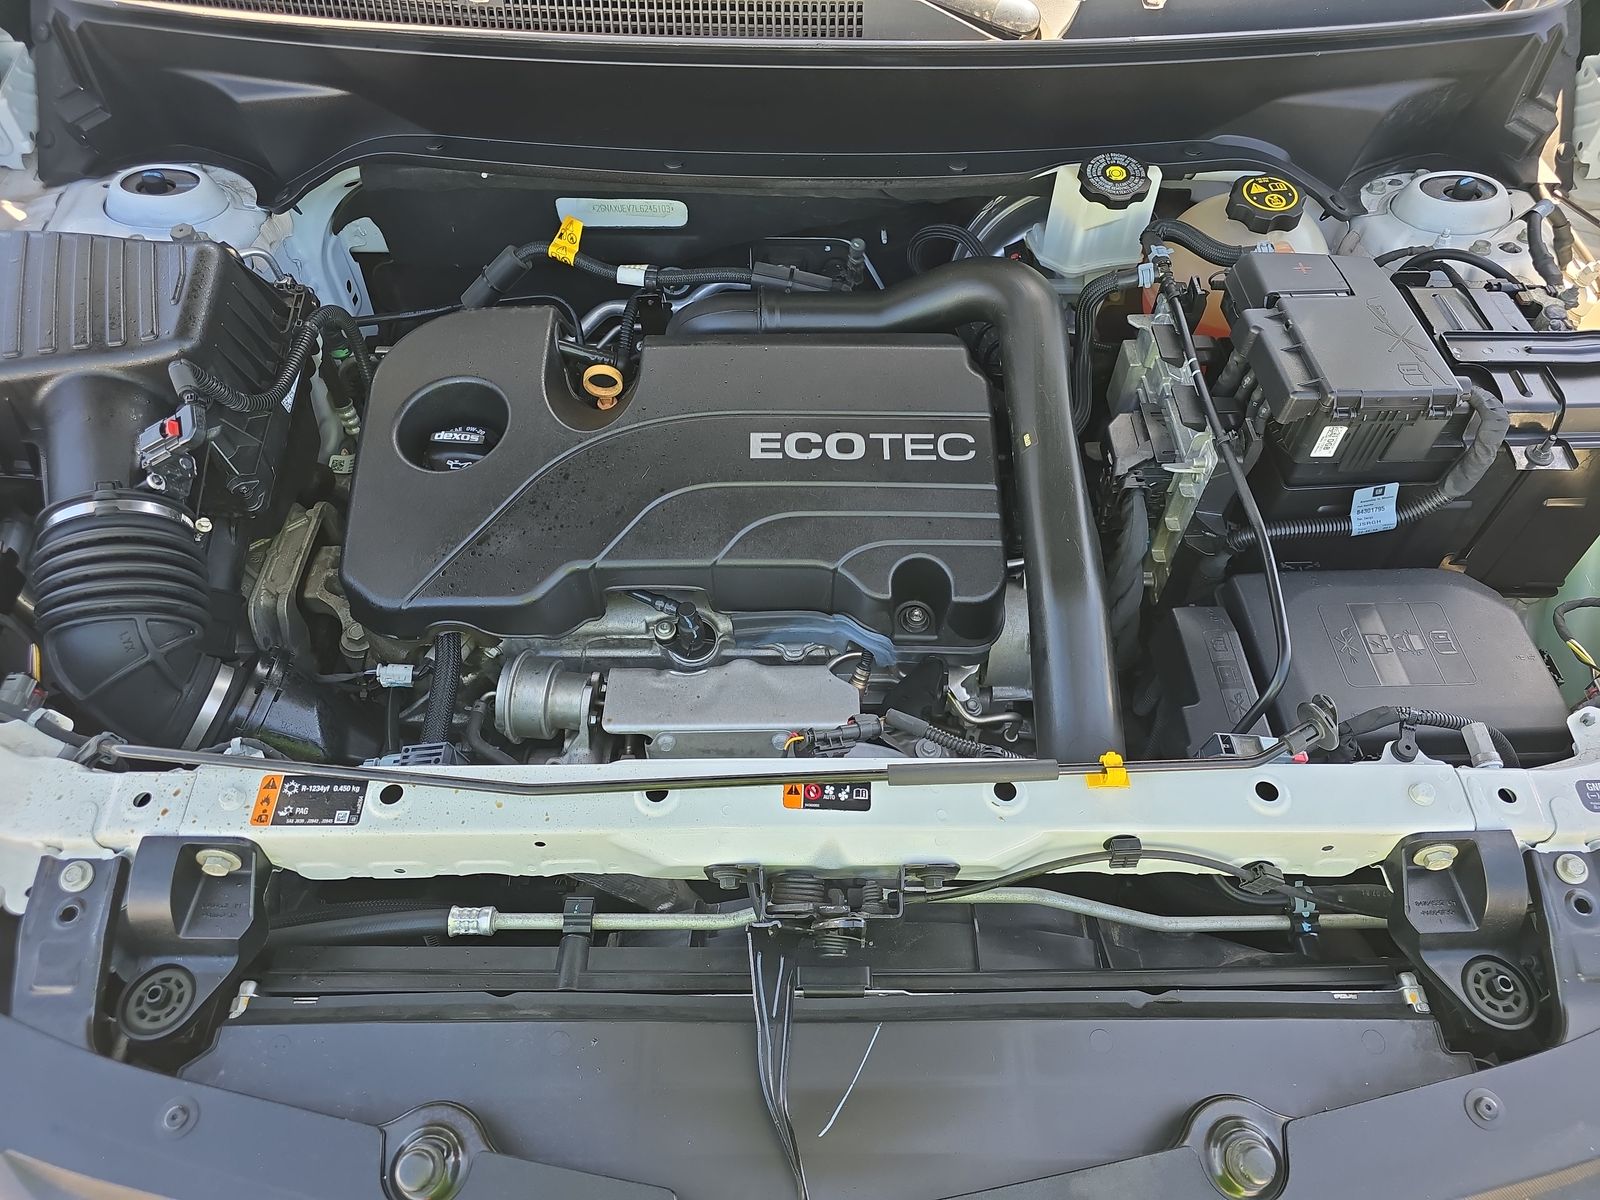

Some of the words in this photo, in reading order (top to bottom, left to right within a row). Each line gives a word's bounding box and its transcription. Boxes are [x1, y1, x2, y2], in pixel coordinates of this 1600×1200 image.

[434, 431, 479, 441] dexos
[750, 432, 976, 461] ECOTEC
[301, 784, 330, 794] R-1234yf
[333, 784, 351, 792] 0.450
[351, 785, 360, 793] kg
[1586, 782, 1600, 791] GN
[295, 807, 309, 815] PAG
